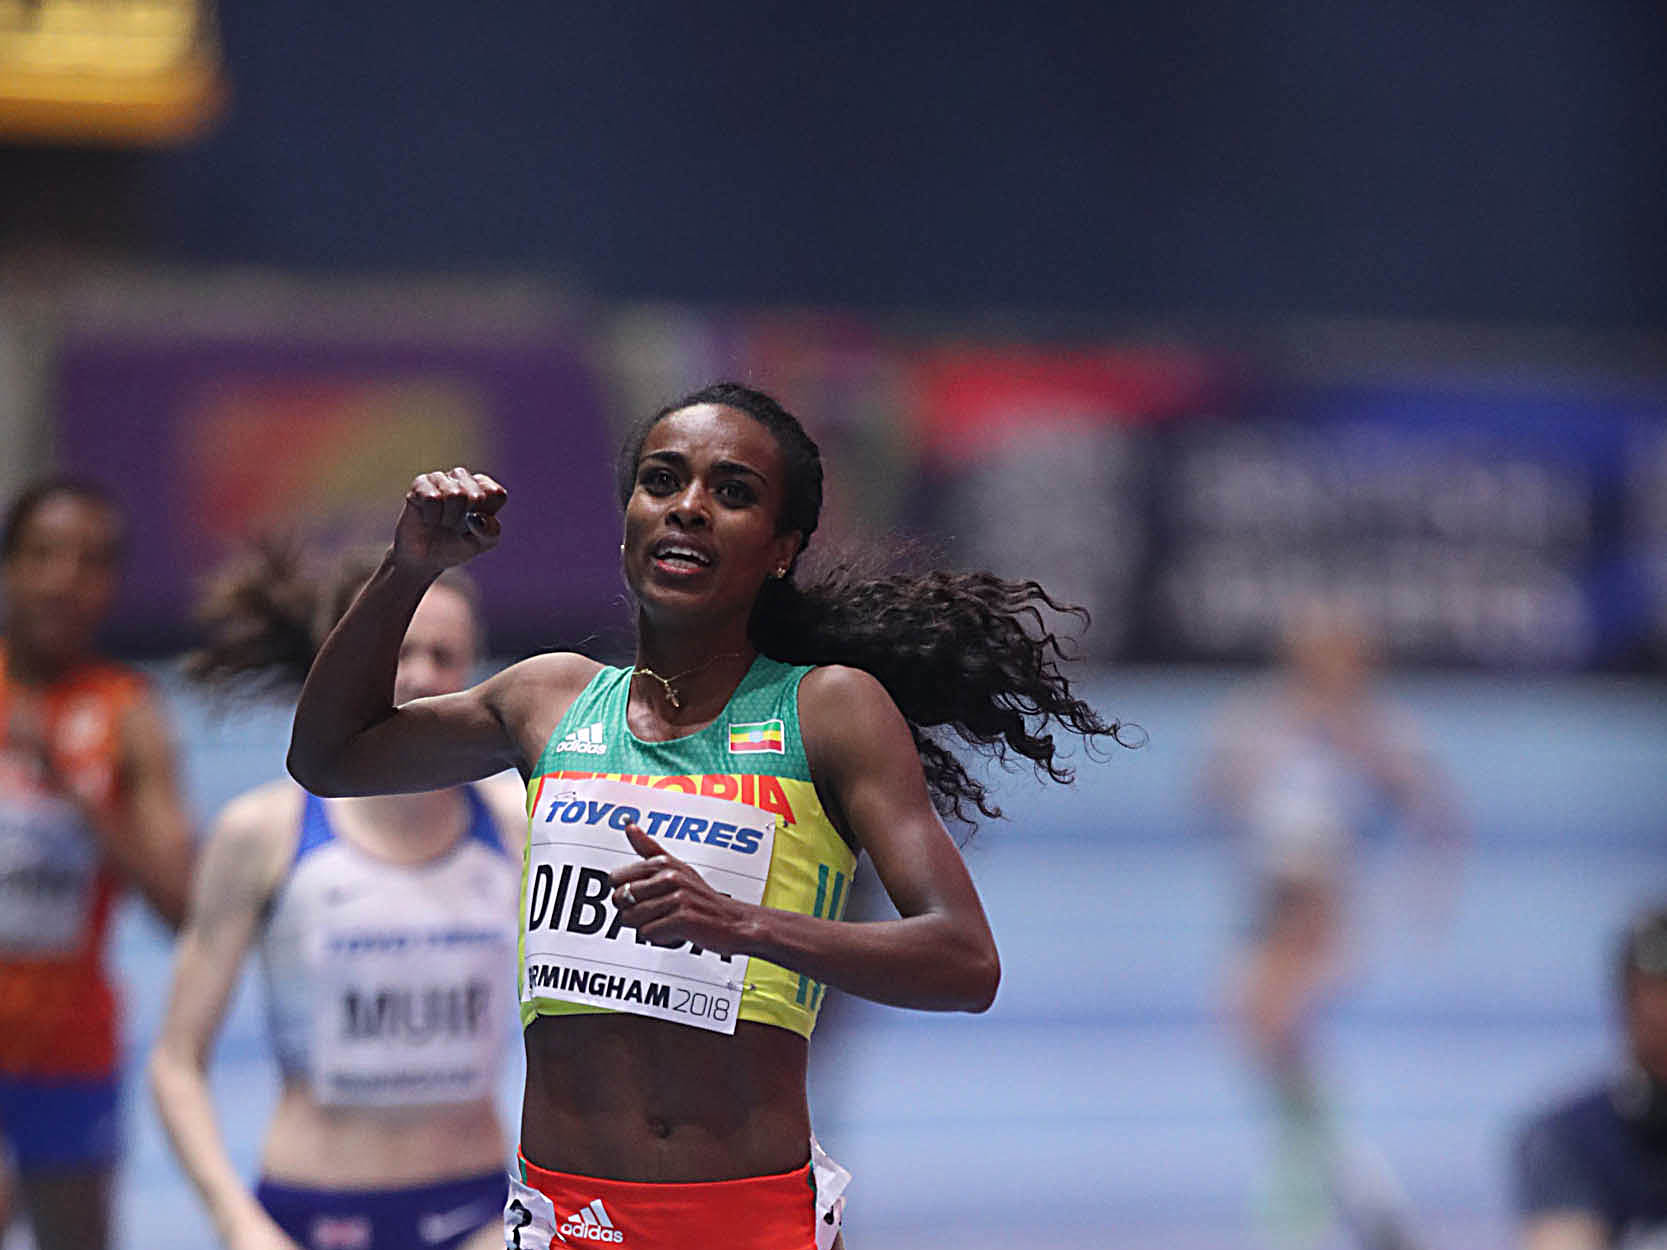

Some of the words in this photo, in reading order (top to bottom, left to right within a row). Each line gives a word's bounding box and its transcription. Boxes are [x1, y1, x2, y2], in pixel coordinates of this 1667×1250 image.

[556, 740, 607, 755] adidas
[545, 800, 641, 832] TOYO
[646, 811, 764, 855] TIRES
[529, 864, 733, 964] DIB
[673, 987, 731, 1022] 2018
[560, 1223, 624, 1243] adidas
